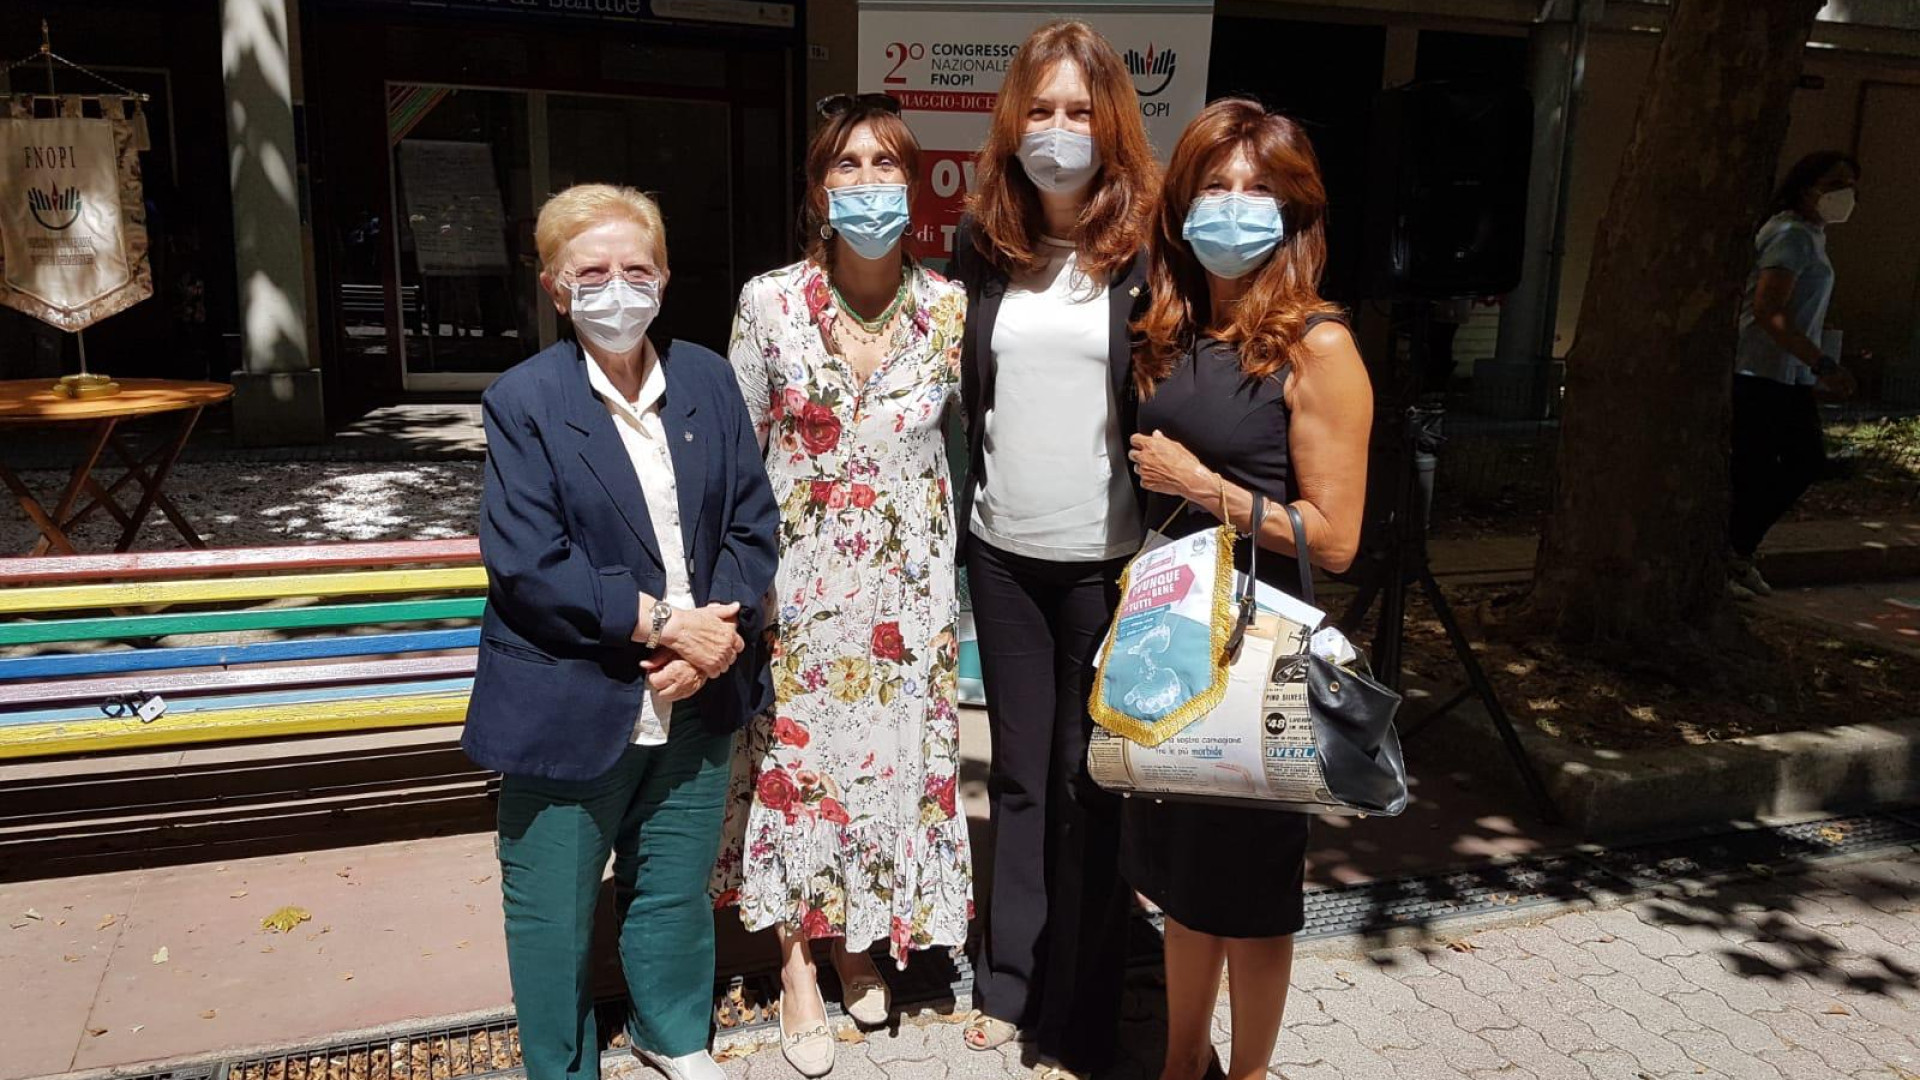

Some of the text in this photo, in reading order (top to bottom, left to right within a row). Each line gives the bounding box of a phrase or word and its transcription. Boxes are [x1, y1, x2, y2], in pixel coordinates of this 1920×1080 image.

[931, 43, 1020, 57] CONGRESSO
[931, 59, 1009, 72] NAZIONALE
[930, 73, 974, 86] FNOPI
[1139, 102, 1170, 117] OPI
[24, 145, 76, 169] FNOPI
[916, 224, 935, 242] di
[1191, 745, 1223, 756] morbide
